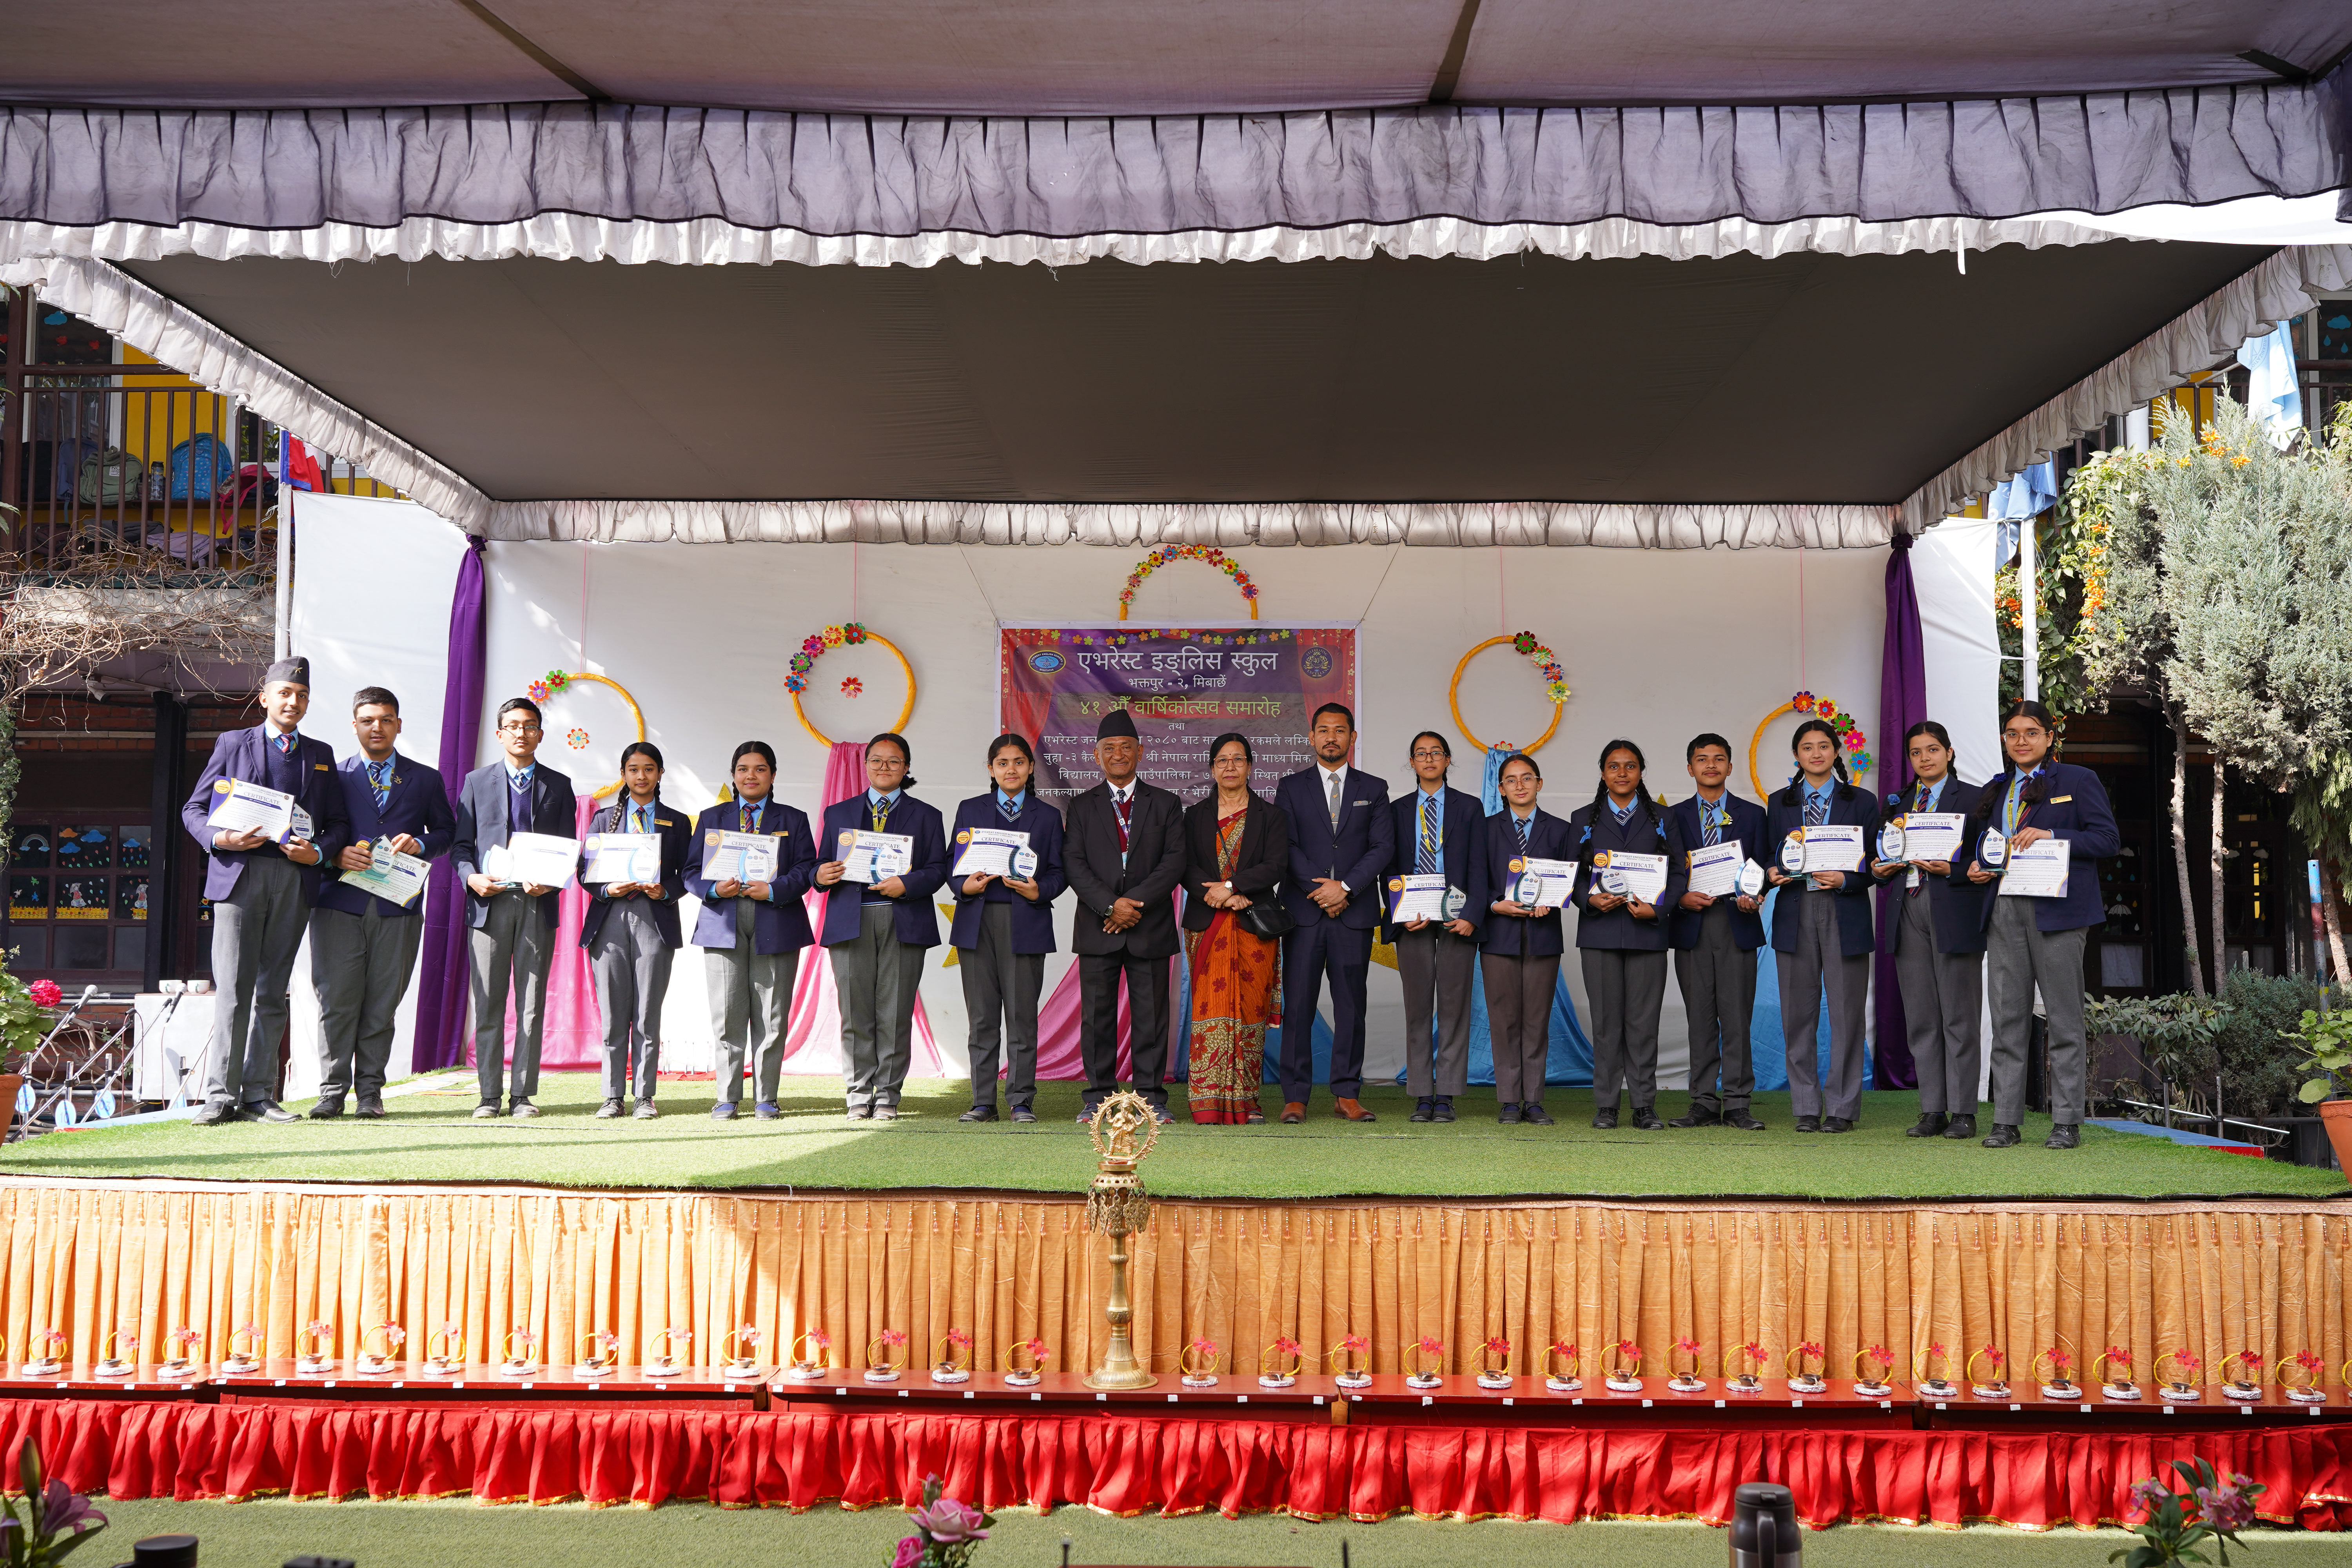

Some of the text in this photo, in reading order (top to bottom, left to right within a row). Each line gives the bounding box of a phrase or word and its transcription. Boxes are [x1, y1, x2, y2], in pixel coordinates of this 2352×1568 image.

[2251, 336, 2267, 369] ORGANIZATIO
[1077, 646, 1143, 674] एभरेस्ट
[1230, 652, 1278, 677] स्कुल
[1129, 678, 1164, 691] भक्तपुर
[1193, 675, 1227, 688] मिबाछें
[1081, 701, 1100, 716] ४१
[1134, 696, 1220, 715] वार्षिकोत्सव
[1225, 697, 1281, 718] समारोह
[1044, 733, 1078, 747] एभरेस्ट
[1147, 735, 1176, 746] २०८०
[1181, 736, 1200, 745] बाट
[1250, 734, 1281, 745] रकमले
[1044, 753, 1063, 765] चुहा
[1146, 750, 1159, 762] श्री
[1162, 750, 1189, 762] नेपाल
[1058, 768, 1102, 781] विद्यालय,
[1254, 768, 1279, 780] स्थित
[244, 791, 280, 805] CERTIFICATE
[1182, 789, 1189, 797] र
[1699, 851, 1731, 862] CERTIFICATE
[394, 860, 416, 872] TIFICATE
